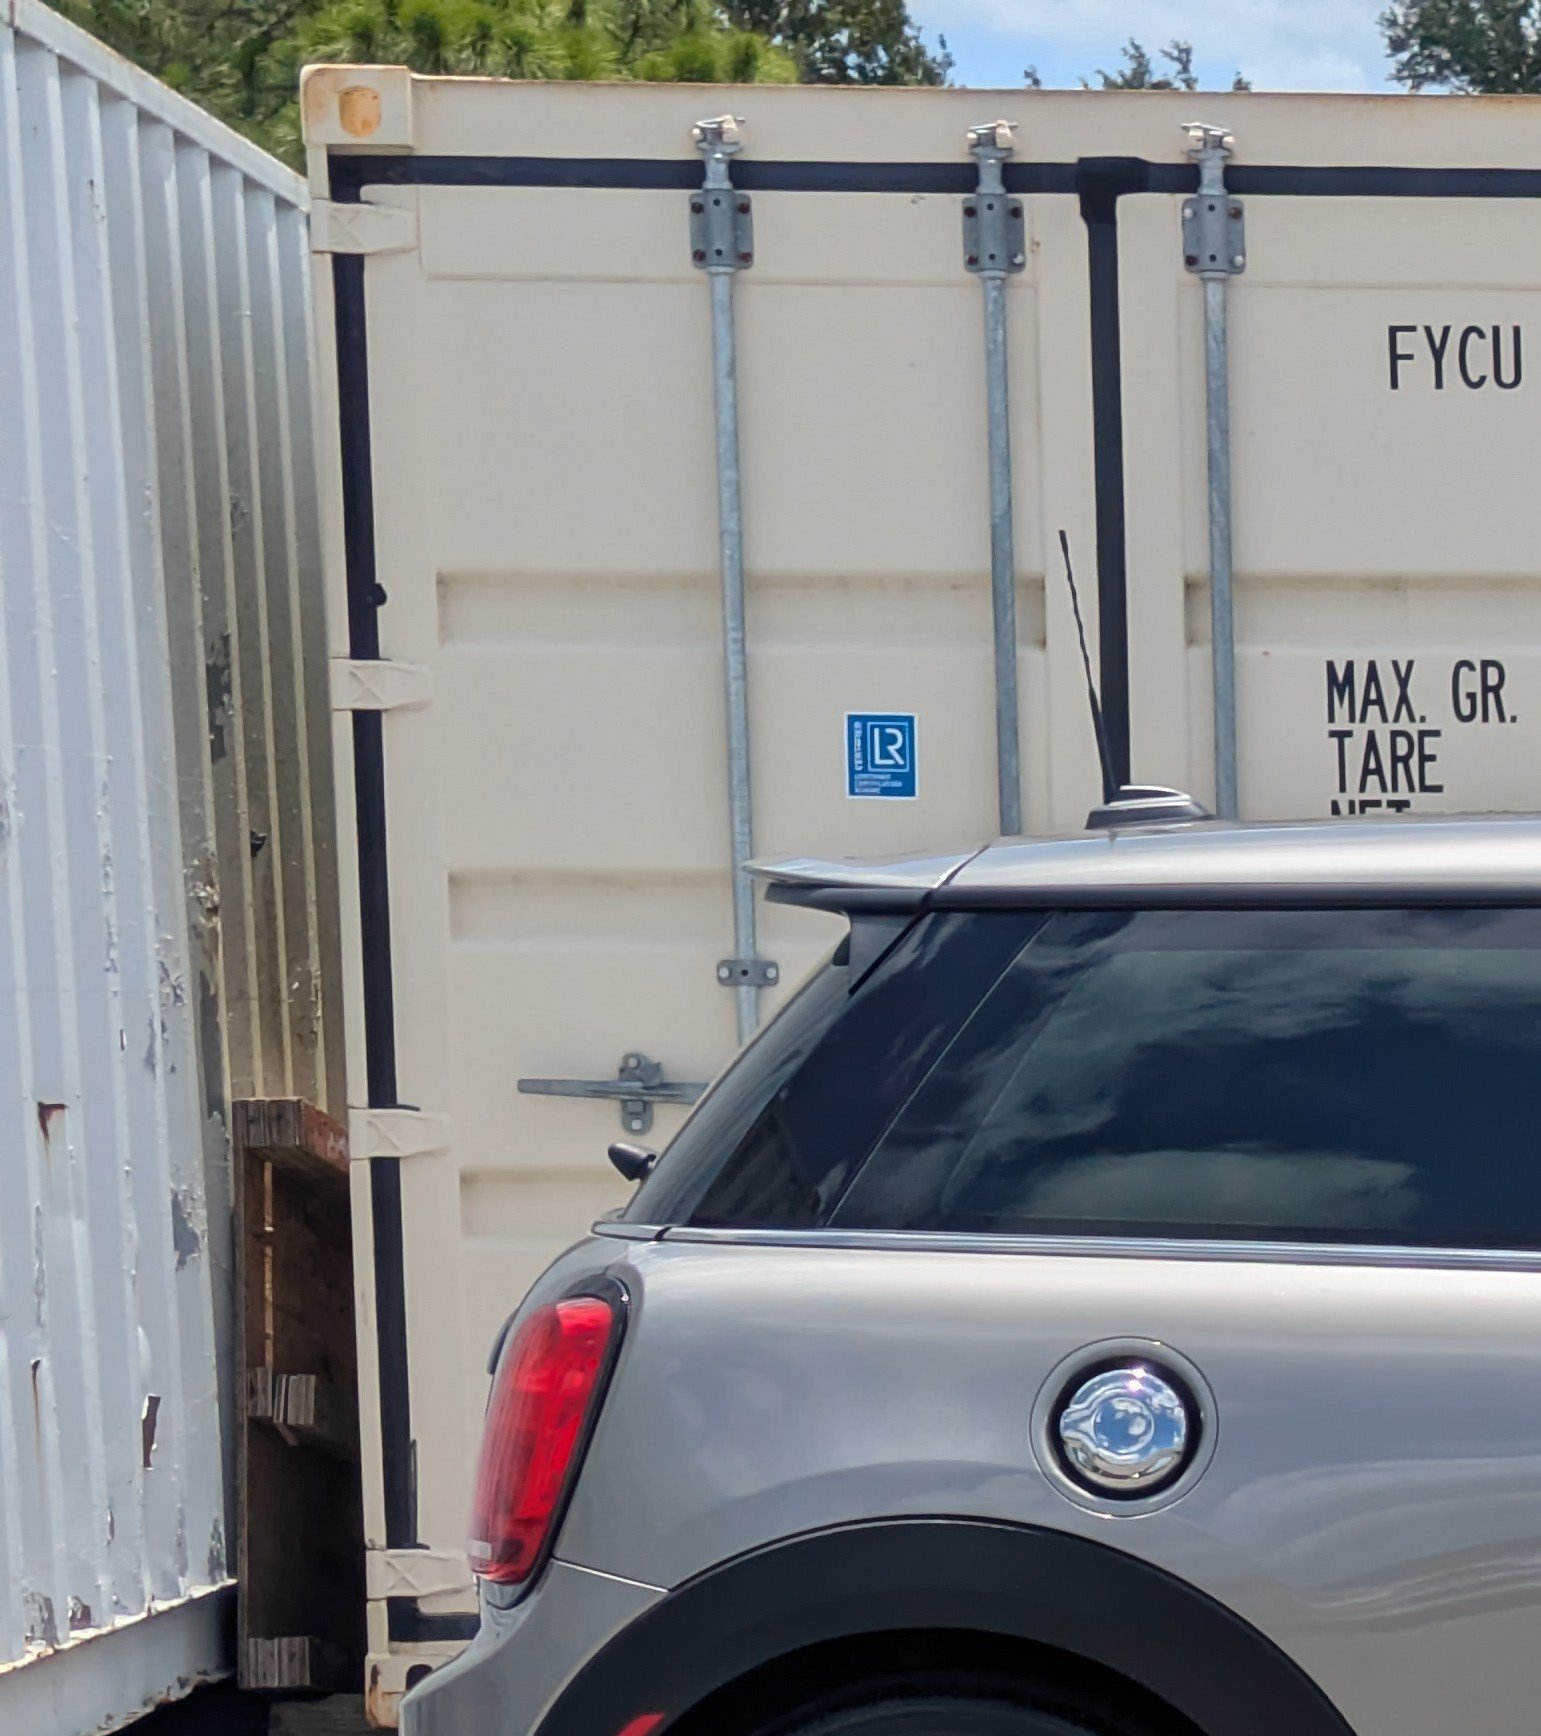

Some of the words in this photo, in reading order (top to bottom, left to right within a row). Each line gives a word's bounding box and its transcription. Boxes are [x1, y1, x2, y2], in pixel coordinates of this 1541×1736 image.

[1388, 326, 1521, 390] FYCU
[1326, 660, 1426, 723] MAX.
[1452, 660, 1517, 723] GR.
[873, 727, 905, 766] LR
[1329, 730, 1443, 793] TARE
